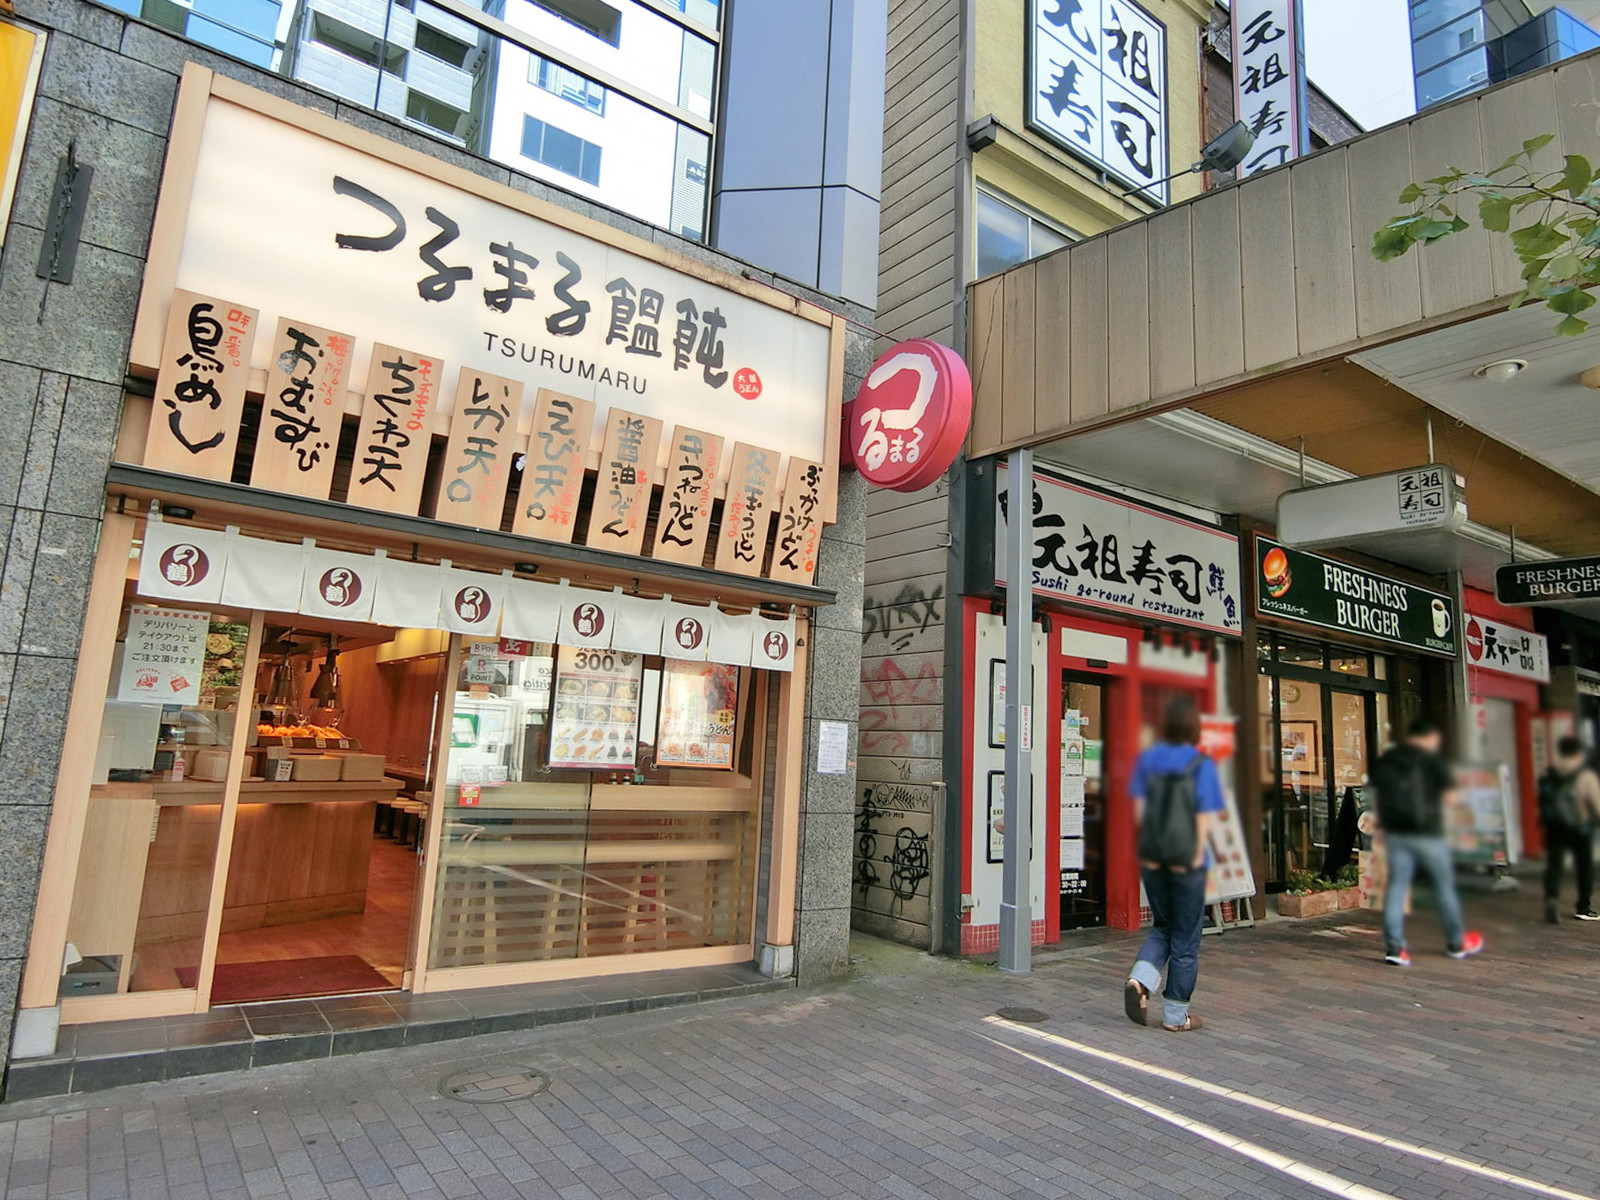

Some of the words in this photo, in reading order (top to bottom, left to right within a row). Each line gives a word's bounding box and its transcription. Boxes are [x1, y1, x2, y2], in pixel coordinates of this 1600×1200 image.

[1039, 58, 1156, 179] 寿司
[333, 174, 729, 389] つるまる饂飩
[484, 332, 648, 395] TSURUMARU
[359, 356, 418, 492] ちくわ天
[858, 352, 938, 471] つるまる
[1400, 471, 1443, 492] 元祖
[1400, 492, 1441, 510] 寿司
[1032, 514, 1203, 604] 元祖寿司
[1032, 571, 1069, 592] Sushi
[1077, 584, 1135, 606] go-round
[1142, 598, 1205, 621] restaurant
[1323, 563, 1408, 612] FRESHNESS
[139, 631, 197, 643] テイクアウトは
[144, 620, 195, 632] デリバリーと
[1336, 598, 1402, 639] BURGER
[132, 653, 196, 664] ご注文頂けます
[143, 643, 189, 653] 21:30まで
[574, 652, 615, 672] 300
[1484, 626, 1534, 671] 天下一品
